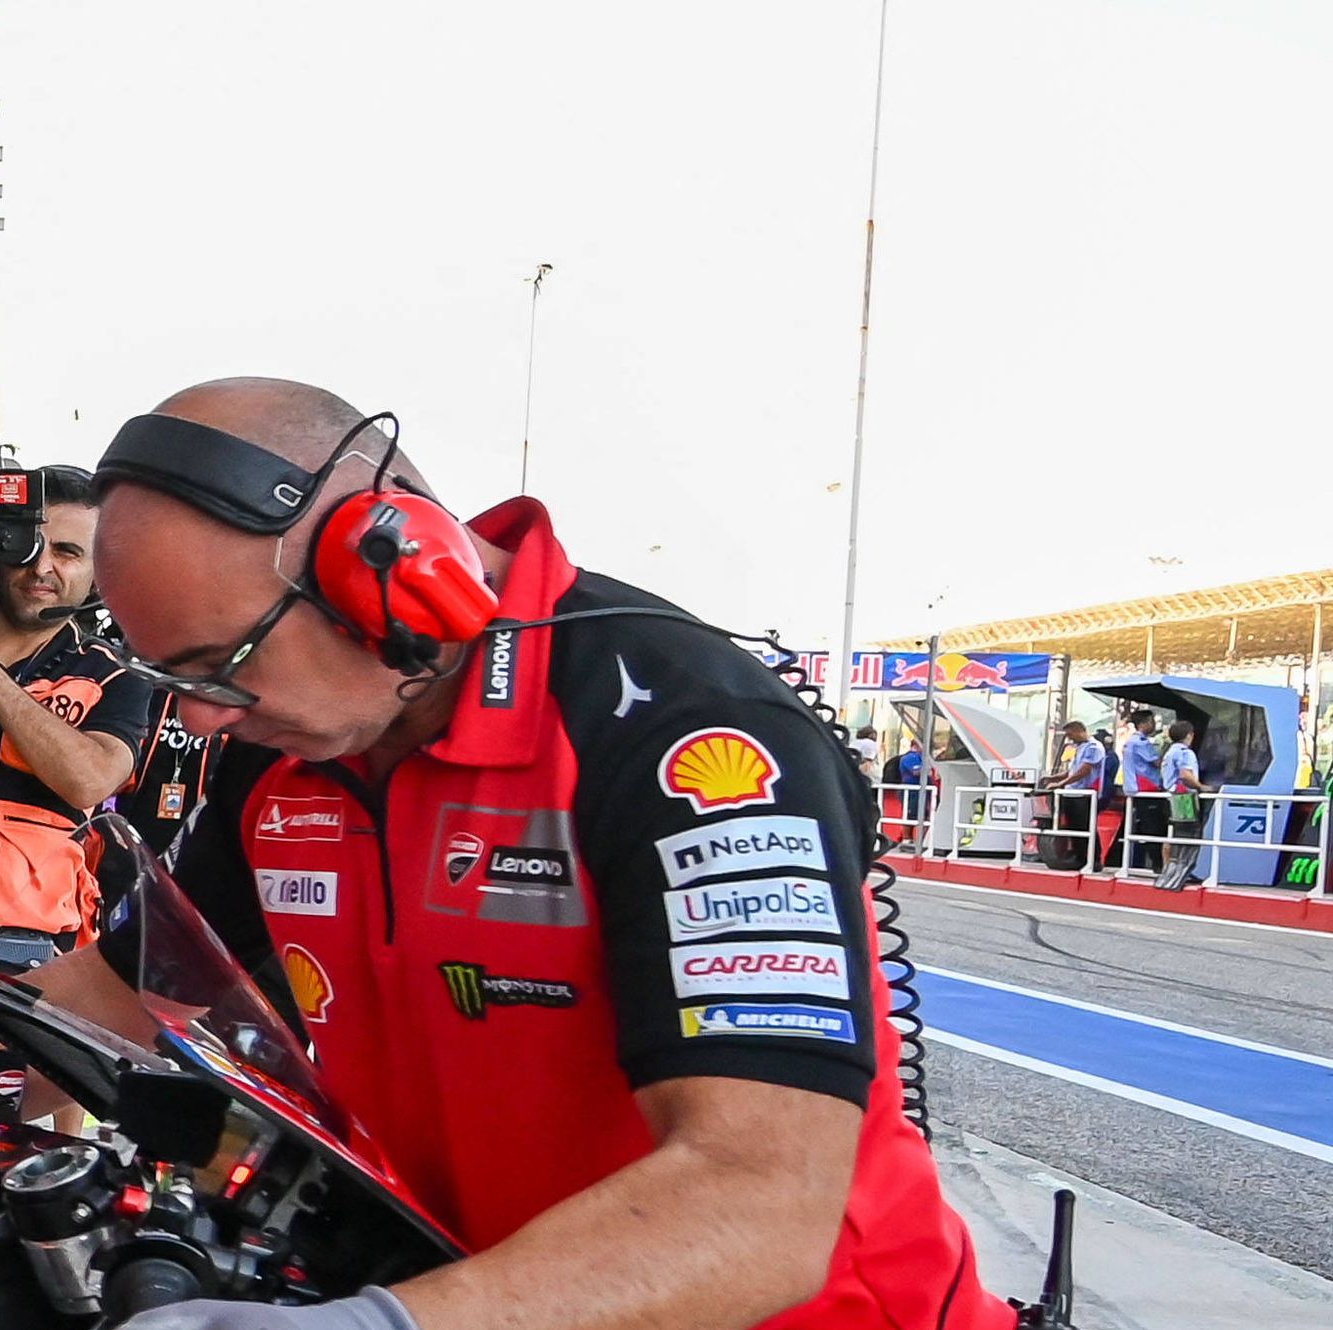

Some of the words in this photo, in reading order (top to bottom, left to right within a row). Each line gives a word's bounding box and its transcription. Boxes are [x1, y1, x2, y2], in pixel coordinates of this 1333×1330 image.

[709, 831, 813, 859] NetApp
[491, 852, 563, 877] Lenovo
[684, 954, 840, 977] CARRERA
[482, 979, 574, 998] MONSTER
[735, 1012, 842, 1031] MICHELIN
